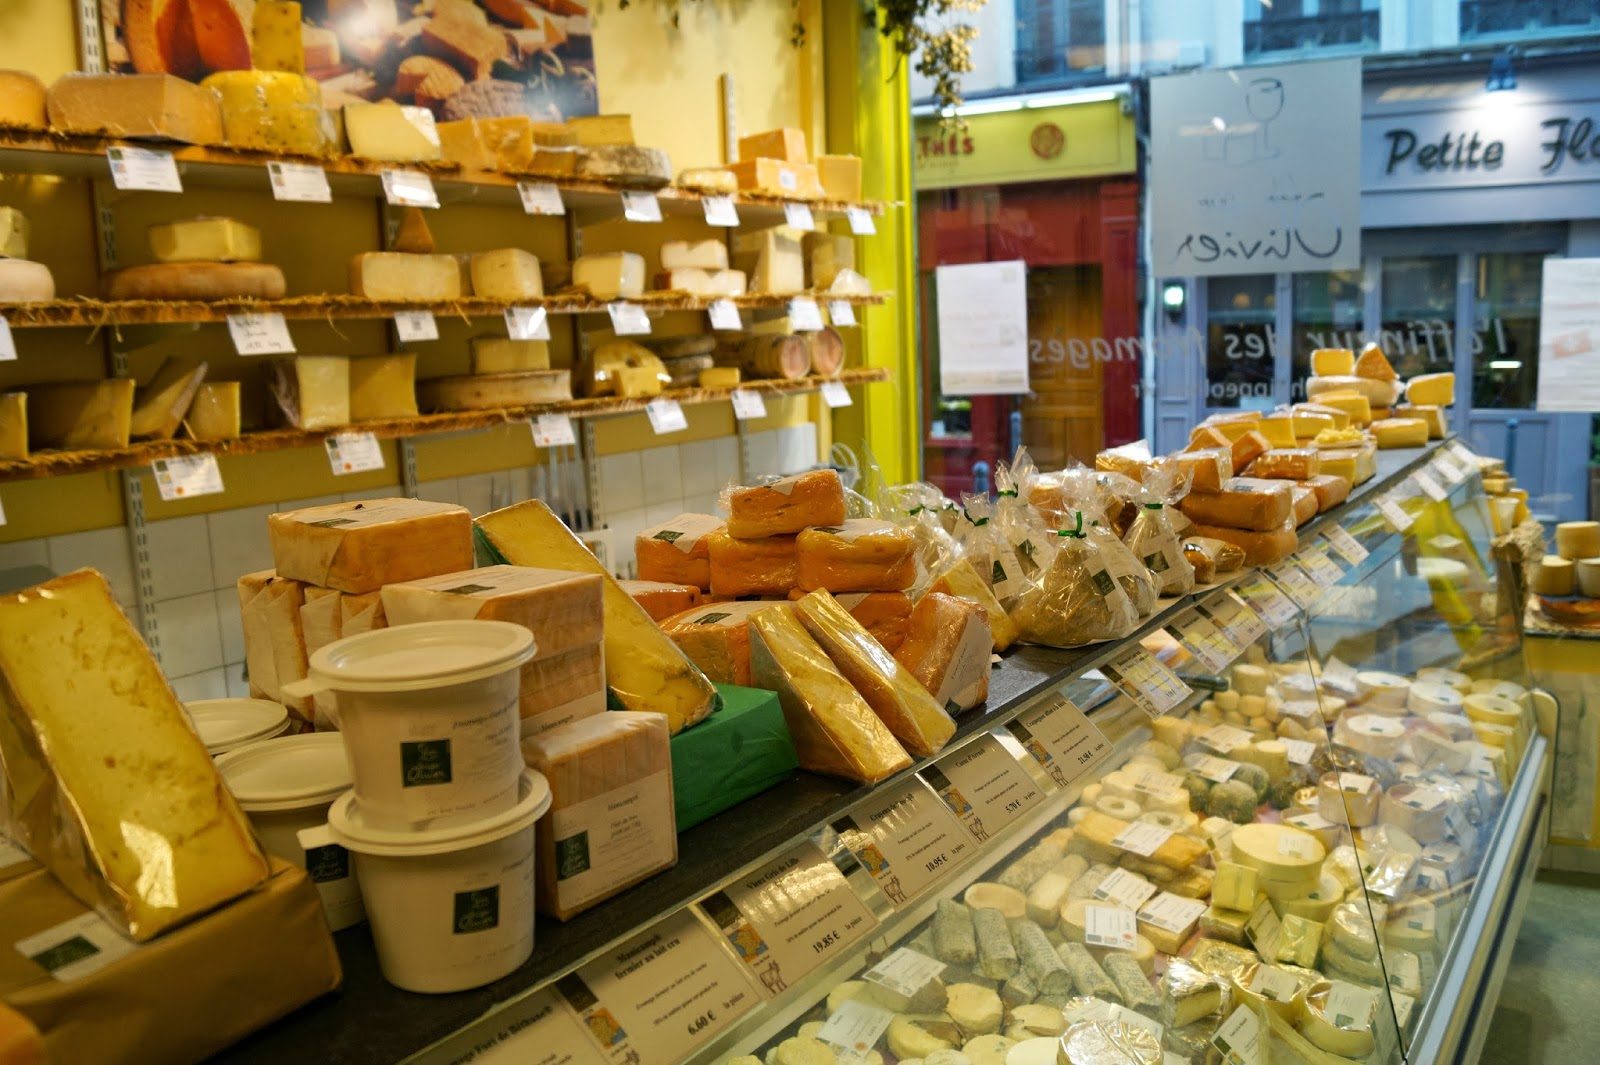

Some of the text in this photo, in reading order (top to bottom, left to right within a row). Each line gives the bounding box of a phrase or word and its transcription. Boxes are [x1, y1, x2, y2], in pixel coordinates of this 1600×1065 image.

[1384, 127, 1504, 174] Petite
[925, 855, 944, 873] 10.95
[667, 938, 681, 950] cru
[812, 934, 835, 954] 19.85
[832, 929, 842, 941] €
[687, 1014, 709, 1036] 6.60
[706, 1009, 717, 1022] €
